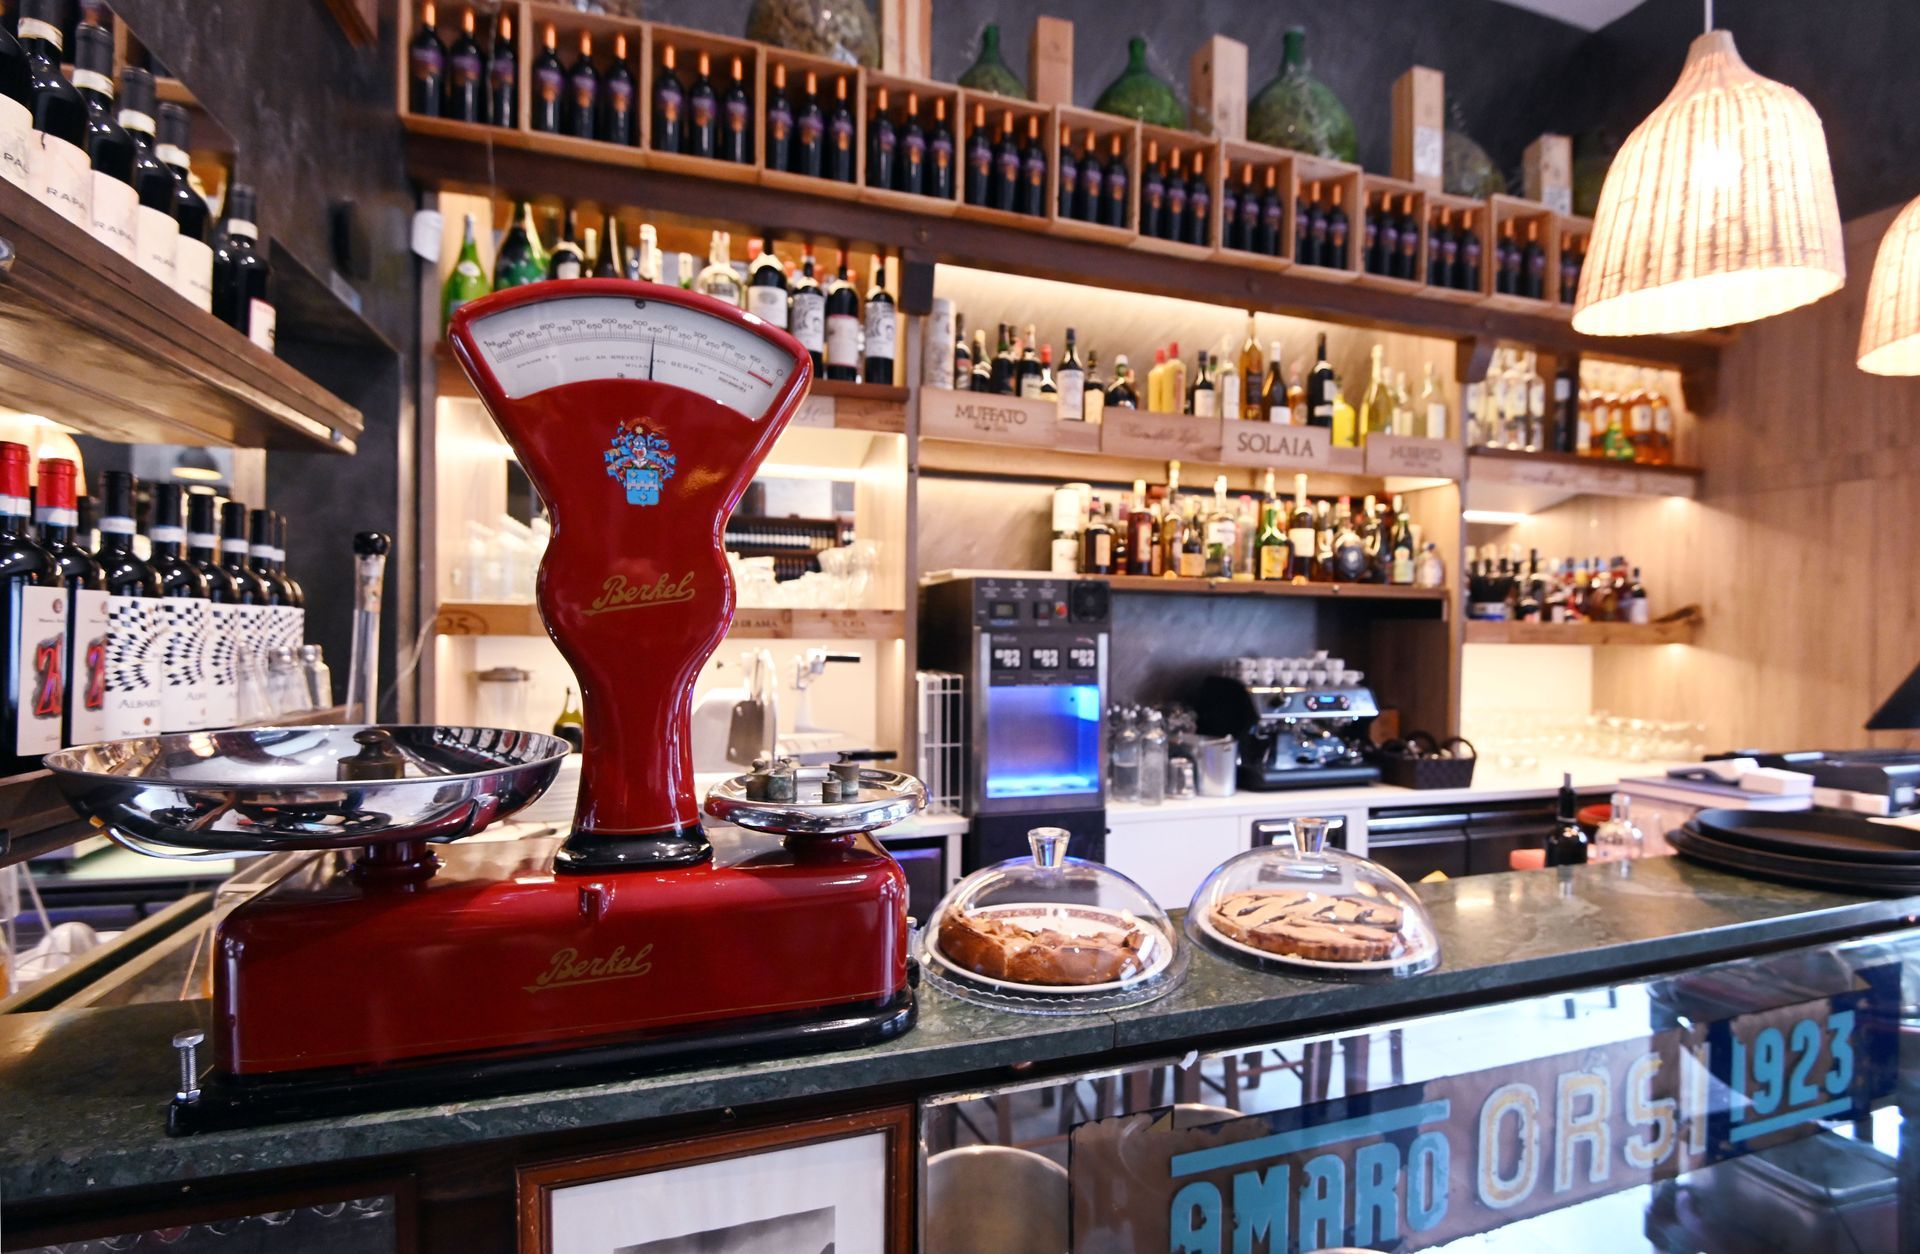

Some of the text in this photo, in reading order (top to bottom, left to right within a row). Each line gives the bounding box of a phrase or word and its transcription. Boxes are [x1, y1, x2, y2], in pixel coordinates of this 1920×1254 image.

[497, 340, 512, 348] 950
[509, 329, 525, 338] 900
[539, 322, 556, 330] 800
[571, 318, 586, 326] 700
[632, 319, 648, 327] 500
[663, 324, 679, 332] 400
[678, 332, 693, 341] 350
[693, 331, 708, 340] 300
[705, 341, 721, 350] 250
[721, 341, 736, 350] 200
[734, 352, 746, 361] 150
[760, 366, 770, 374] 50
[955, 404, 1027, 425] MUFFATO
[1237, 432, 1315, 458] SOLAIA
[586, 571, 696, 613] Berkel
[528, 943, 654, 990] Berkel
[1170, 1011, 1855, 1254] AMARO ORSI 1923
